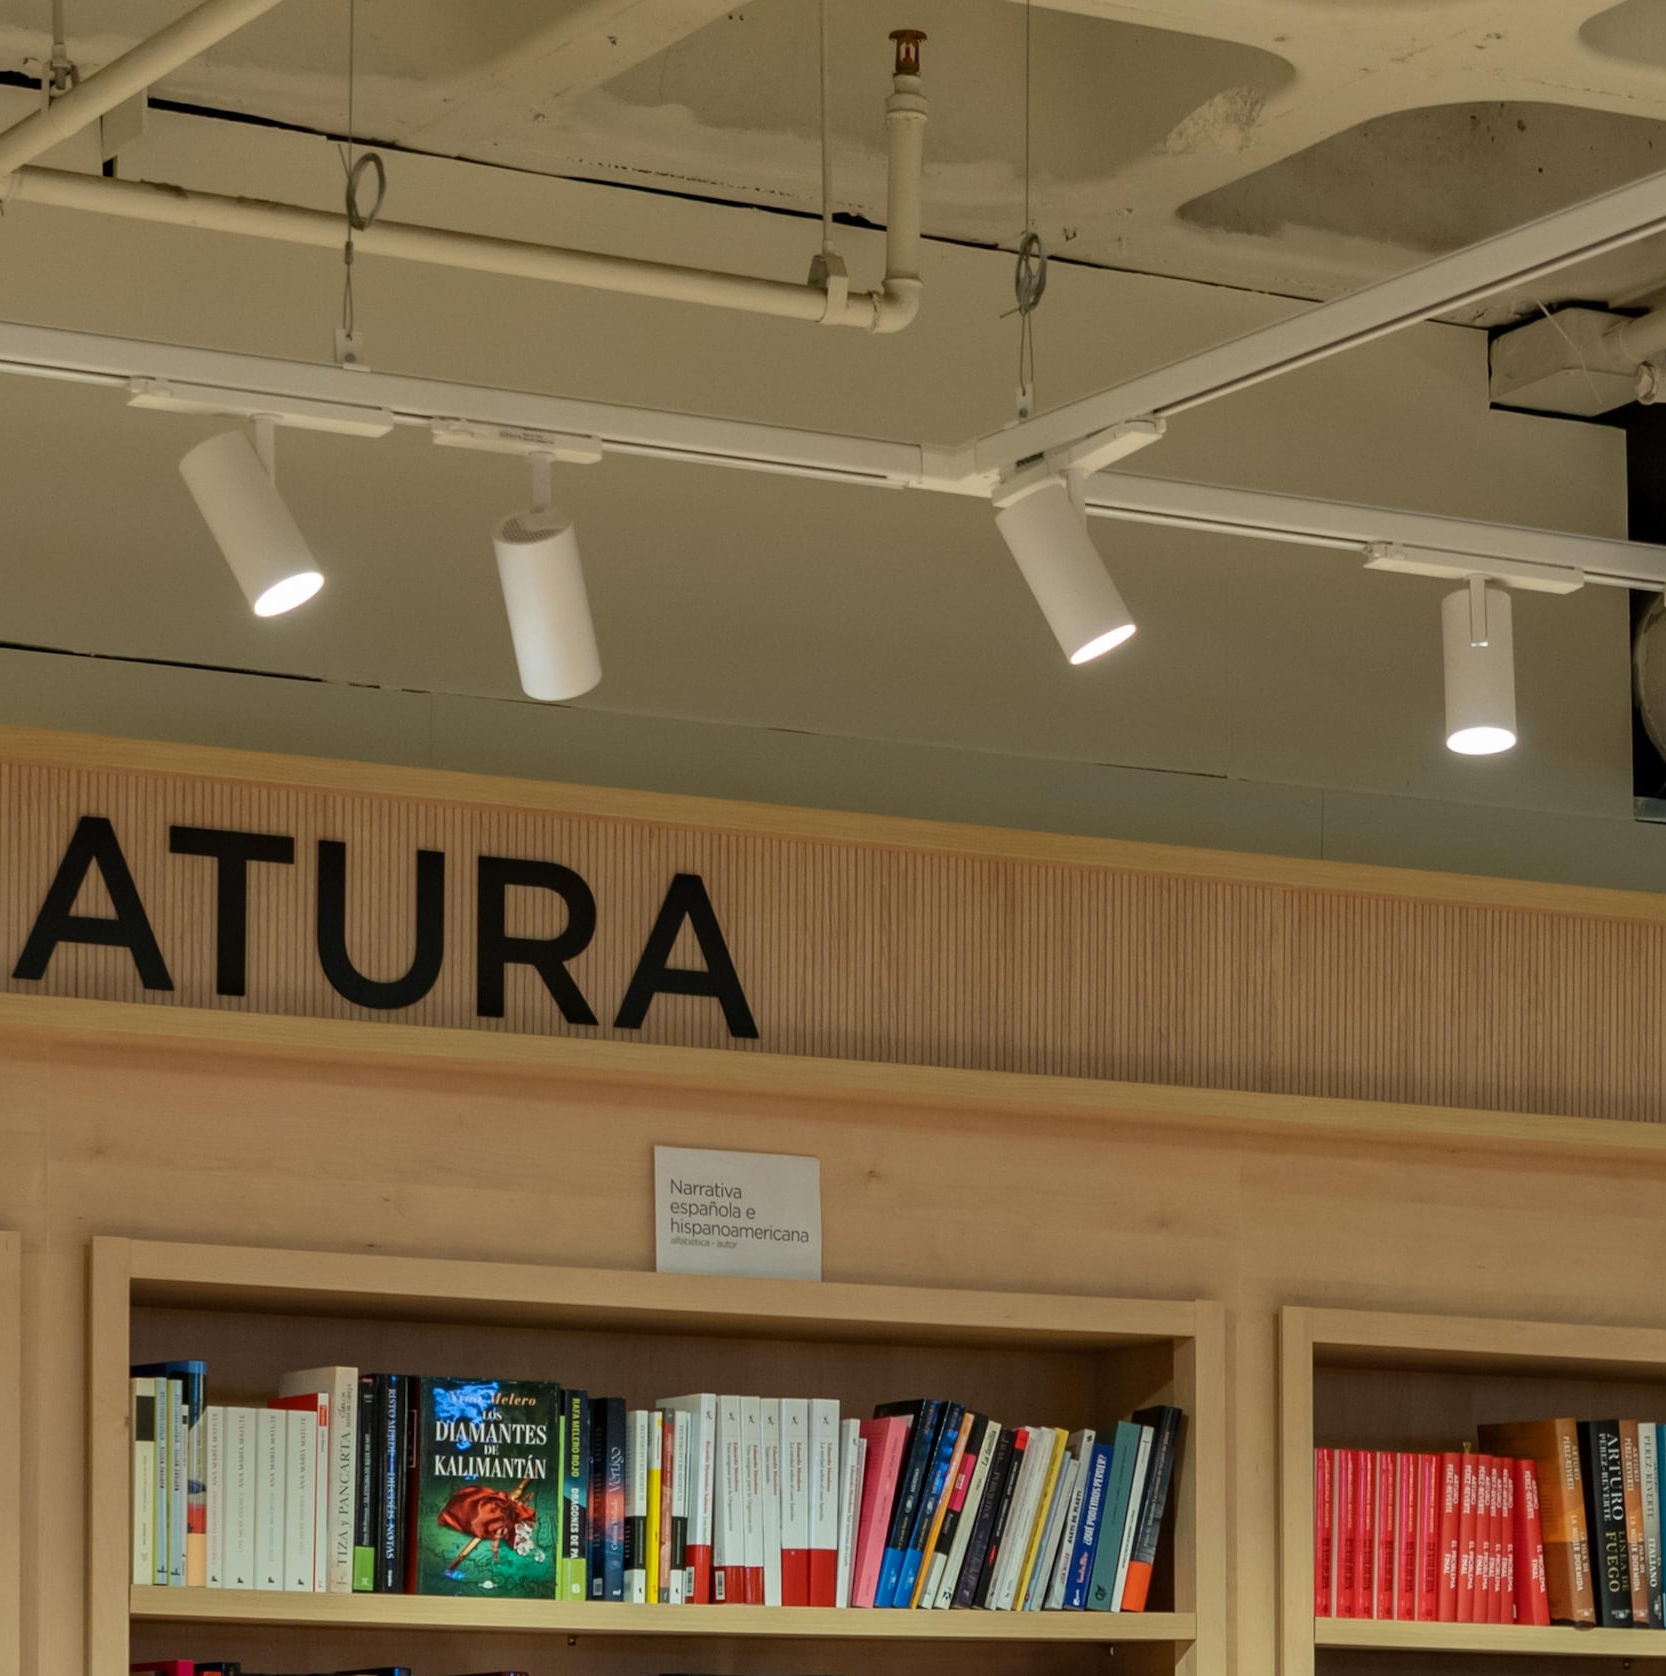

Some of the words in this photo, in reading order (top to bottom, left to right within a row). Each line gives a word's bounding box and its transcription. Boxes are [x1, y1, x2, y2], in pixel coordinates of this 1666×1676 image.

[670, 1179, 742, 1199] Narrativa
[670, 1201, 741, 1219] española
[746, 1207, 756, 1219] e
[670, 1218, 809, 1243] hispanoamericana
[482, 1410, 502, 1421] LOS
[435, 1421, 547, 1445] DIAMANTES
[484, 1445, 499, 1456] DE
[434, 1455, 546, 1479] KALIMANTÁN
[1607, 1433, 1624, 1521] ARTURO
[1605, 1531, 1620, 1593] FUEGO
